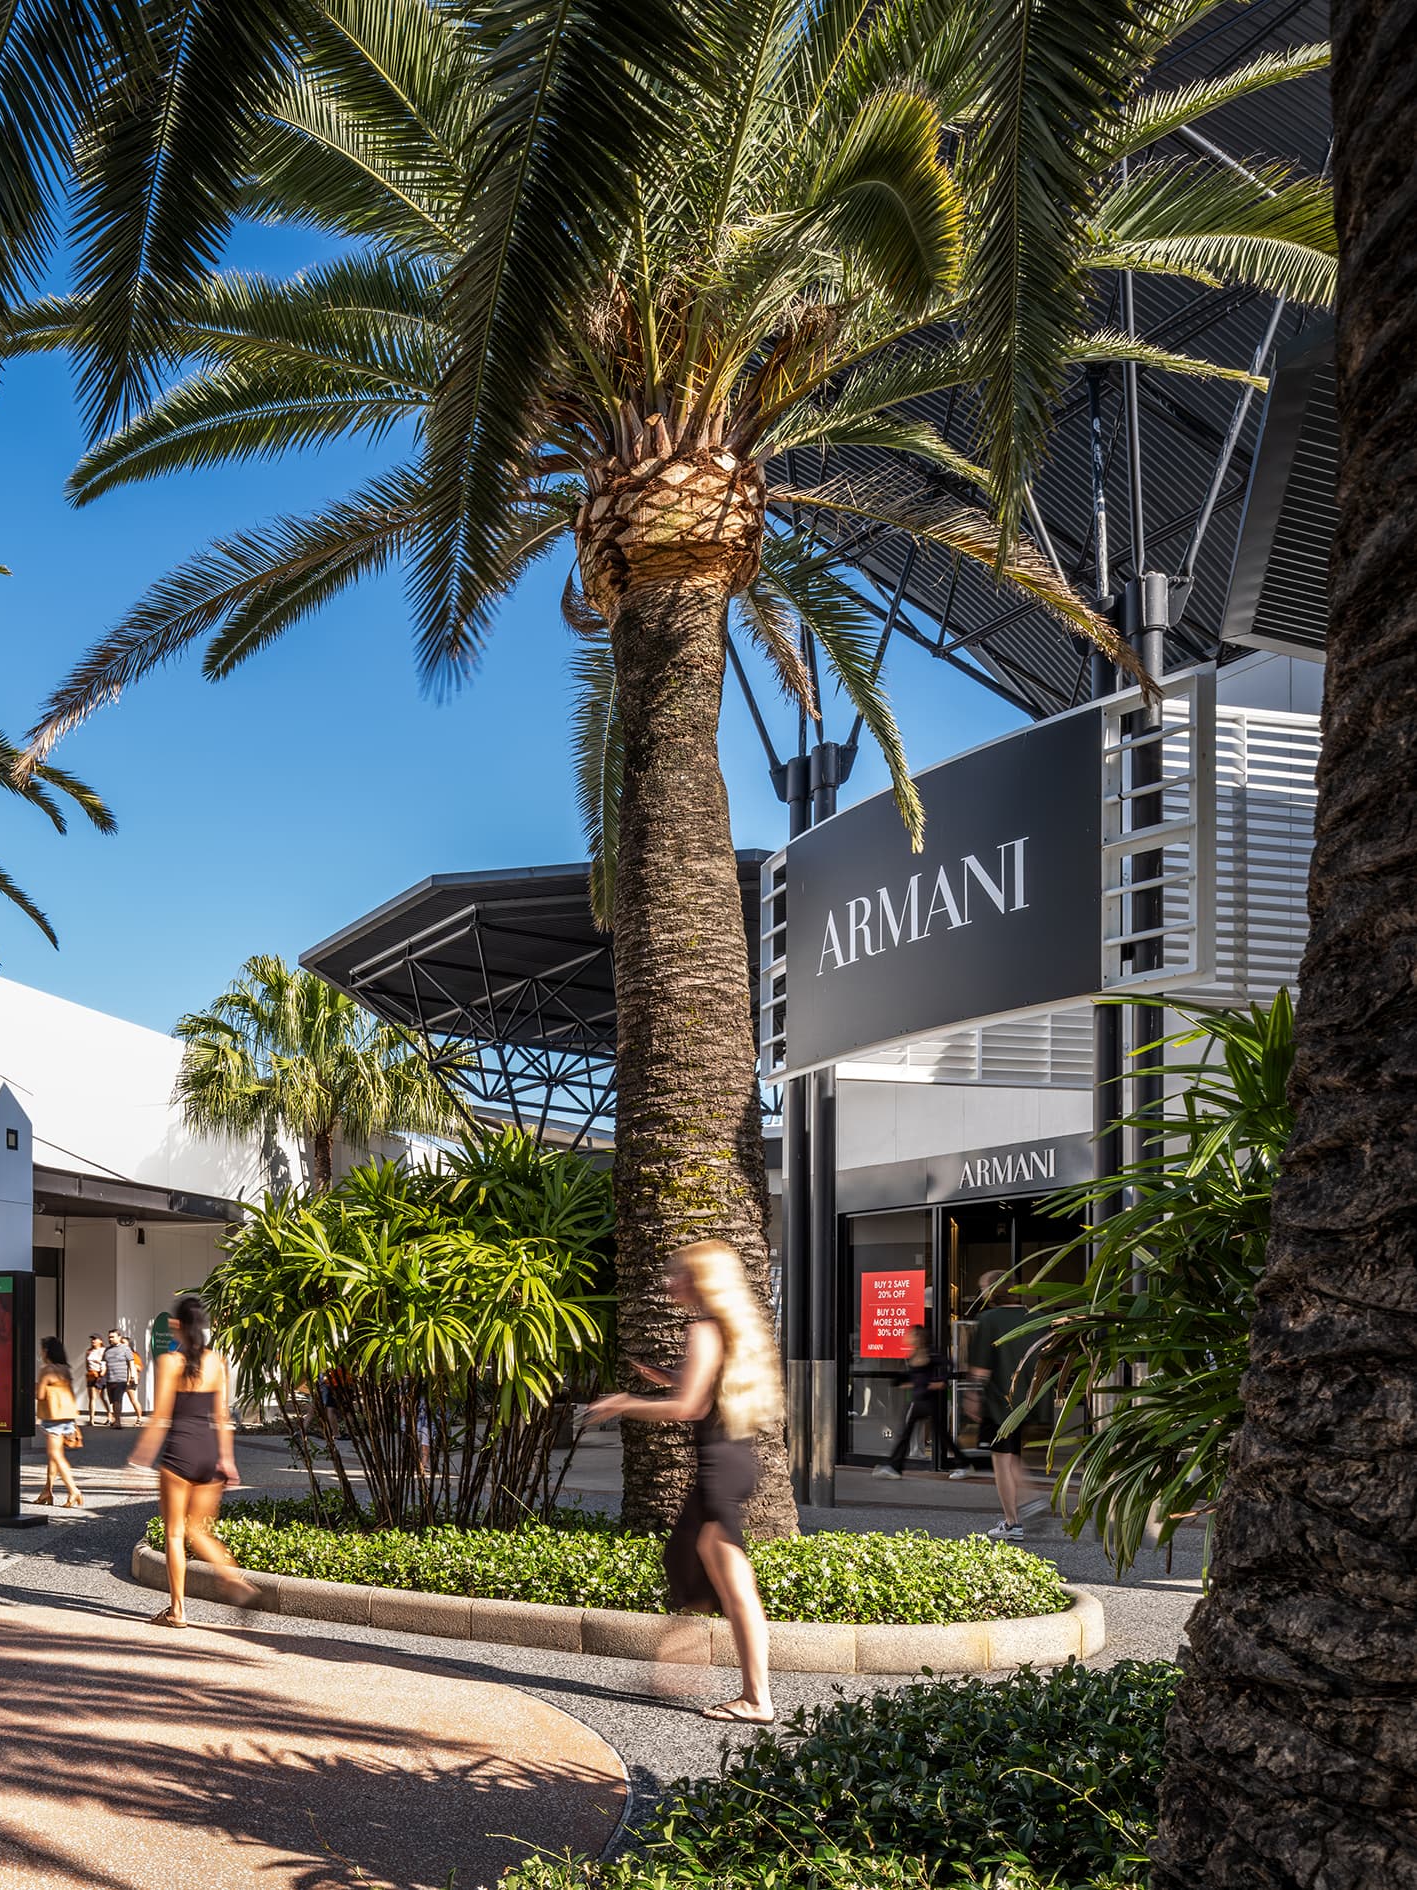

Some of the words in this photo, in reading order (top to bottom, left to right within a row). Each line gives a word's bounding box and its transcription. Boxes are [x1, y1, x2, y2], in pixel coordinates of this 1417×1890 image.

[816, 837, 1030, 976] ARMANI
[958, 1148, 1056, 1189] ARMANI
[874, 1280, 886, 1288] BUY
[888, 1280, 893, 1288] 2
[893, 1280, 910, 1288] SAVE
[878, 1290, 892, 1299] 20%
[892, 1290, 906, 1298] OFF
[876, 1308, 889, 1317] BUY
[890, 1308, 895, 1316] 3
[896, 1308, 907, 1316] OR
[873, 1319, 892, 1327] MORE
[893, 1318, 910, 1327] SAVE
[877, 1328, 892, 1337] 30%
[892, 1328, 905, 1337] OFF
